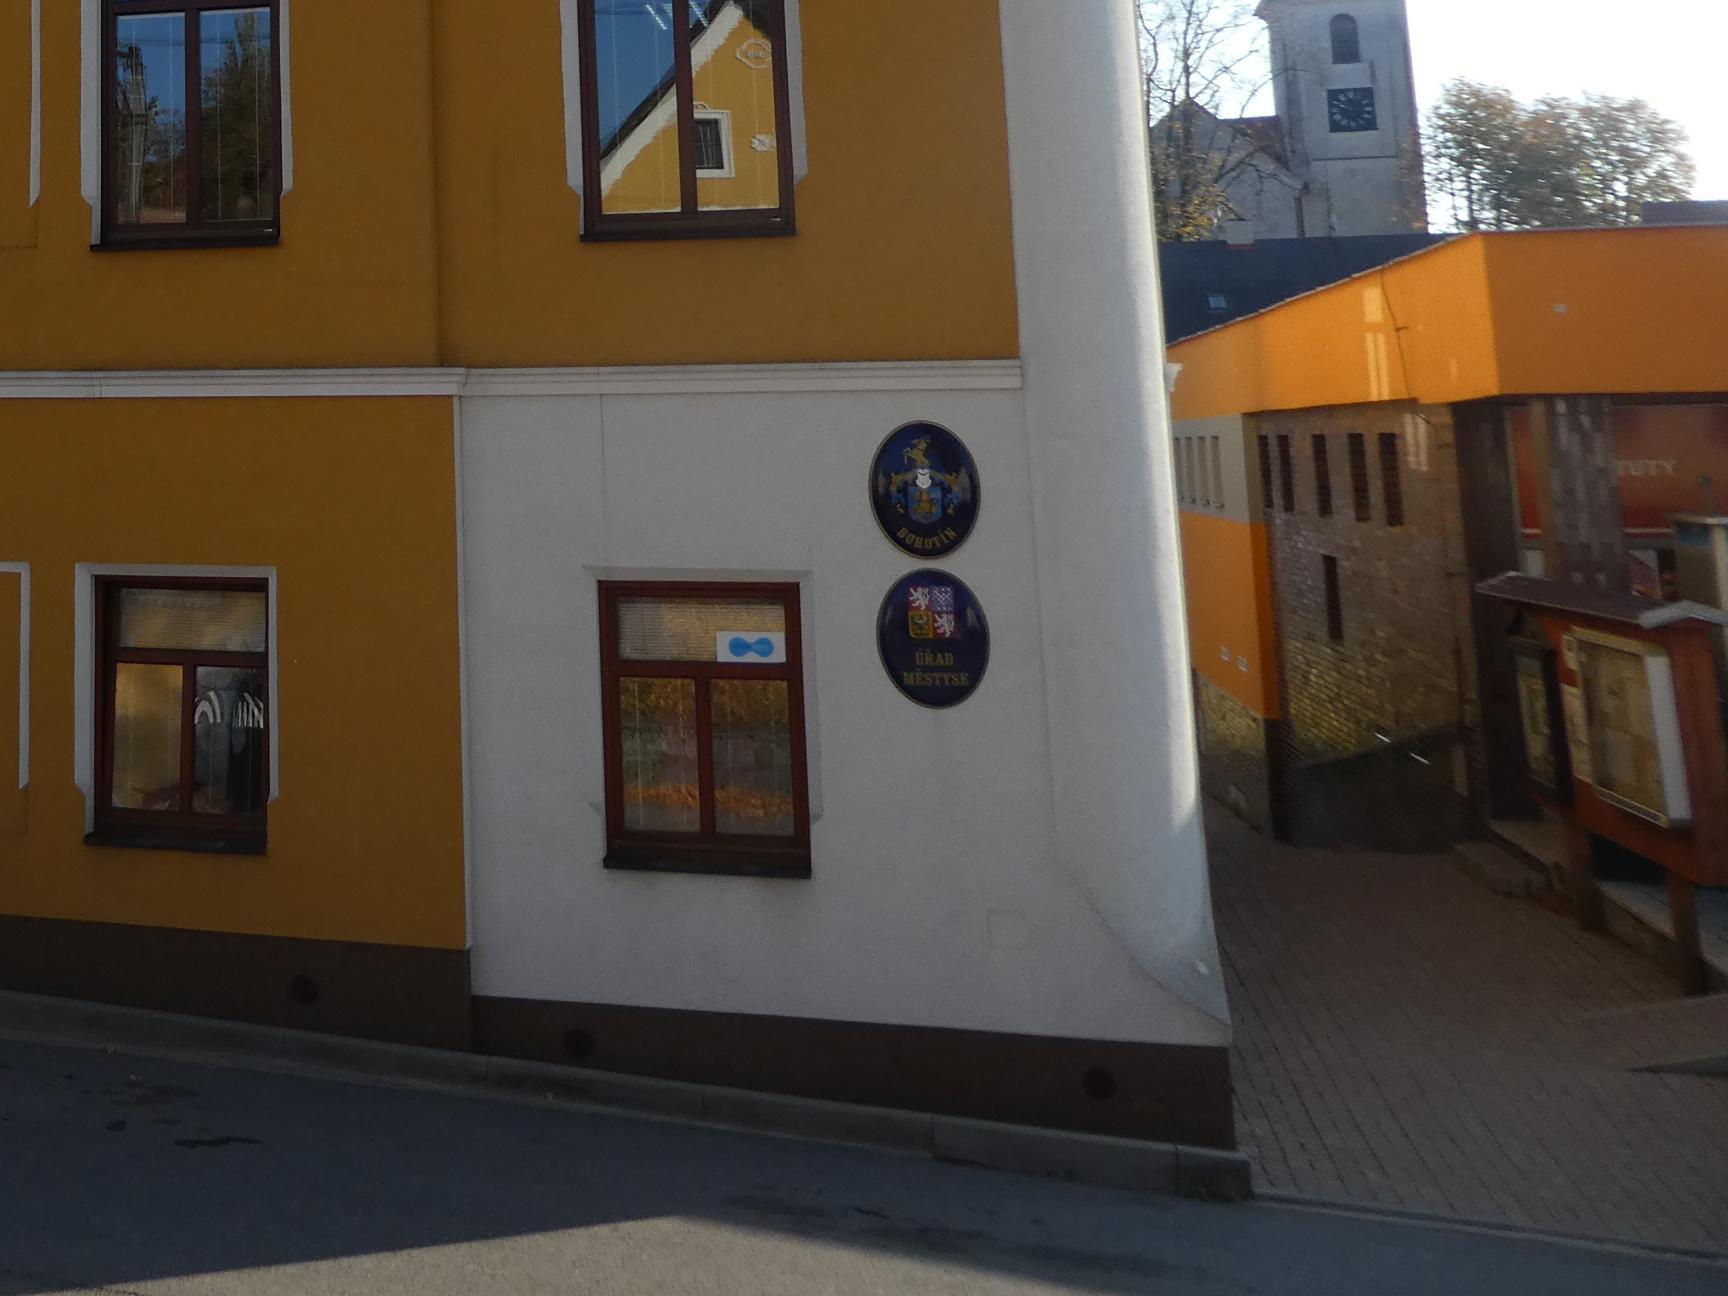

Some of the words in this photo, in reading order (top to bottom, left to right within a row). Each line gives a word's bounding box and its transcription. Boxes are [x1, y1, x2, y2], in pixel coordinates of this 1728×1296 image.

[896, 527, 958, 550] BOROTÍN
[914, 648, 954, 666] ÚŘAD
[903, 667, 970, 686] MĚSTYSE
